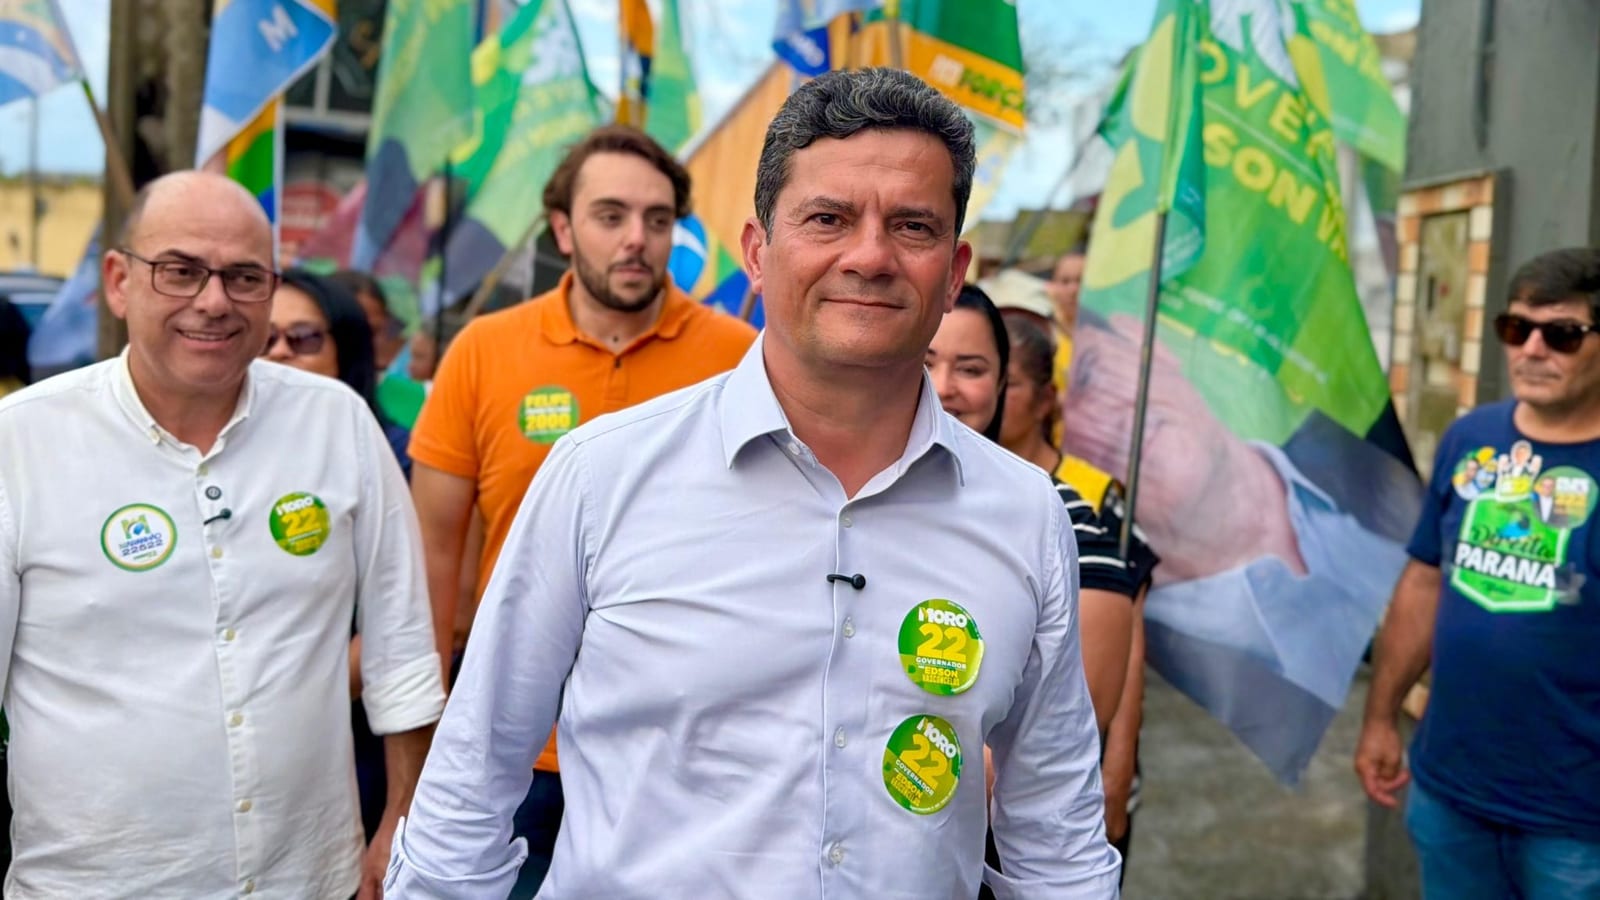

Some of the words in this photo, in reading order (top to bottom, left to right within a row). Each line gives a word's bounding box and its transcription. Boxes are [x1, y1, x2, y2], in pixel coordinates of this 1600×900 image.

[526, 413, 571, 431] 2000
[276, 496, 314, 516] MORO
[281, 506, 321, 537] 22
[918, 606, 968, 628] MORO
[917, 622, 967, 663] 22
[916, 657, 967, 670] GOVERNADOR
[924, 666, 959, 677] EDSON
[916, 717, 957, 758] MORO
[899, 733, 948, 791] 22
[895, 759, 935, 796] GOVERNADOR
